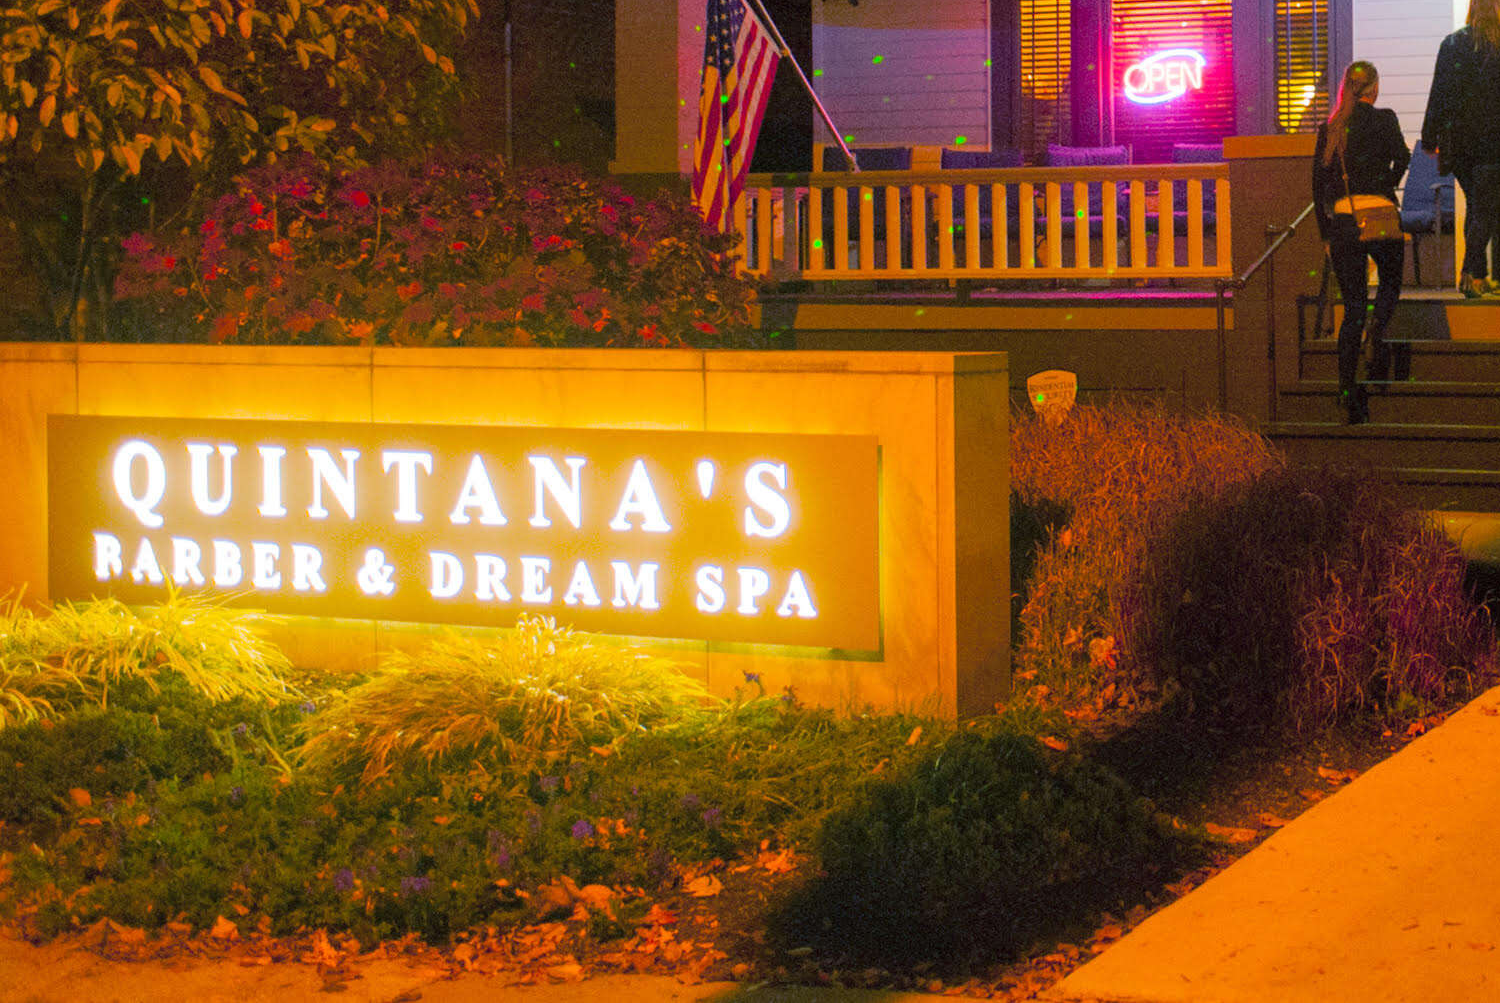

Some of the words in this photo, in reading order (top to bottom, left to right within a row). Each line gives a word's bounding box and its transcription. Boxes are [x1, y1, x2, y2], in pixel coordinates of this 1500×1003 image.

[1123, 61, 1202, 93] OPEN
[112, 439, 792, 539] QUINTANA'S
[356, 548, 397, 596] &
[429, 551, 661, 610] DREAM
[695, 565, 818, 618] SPA
